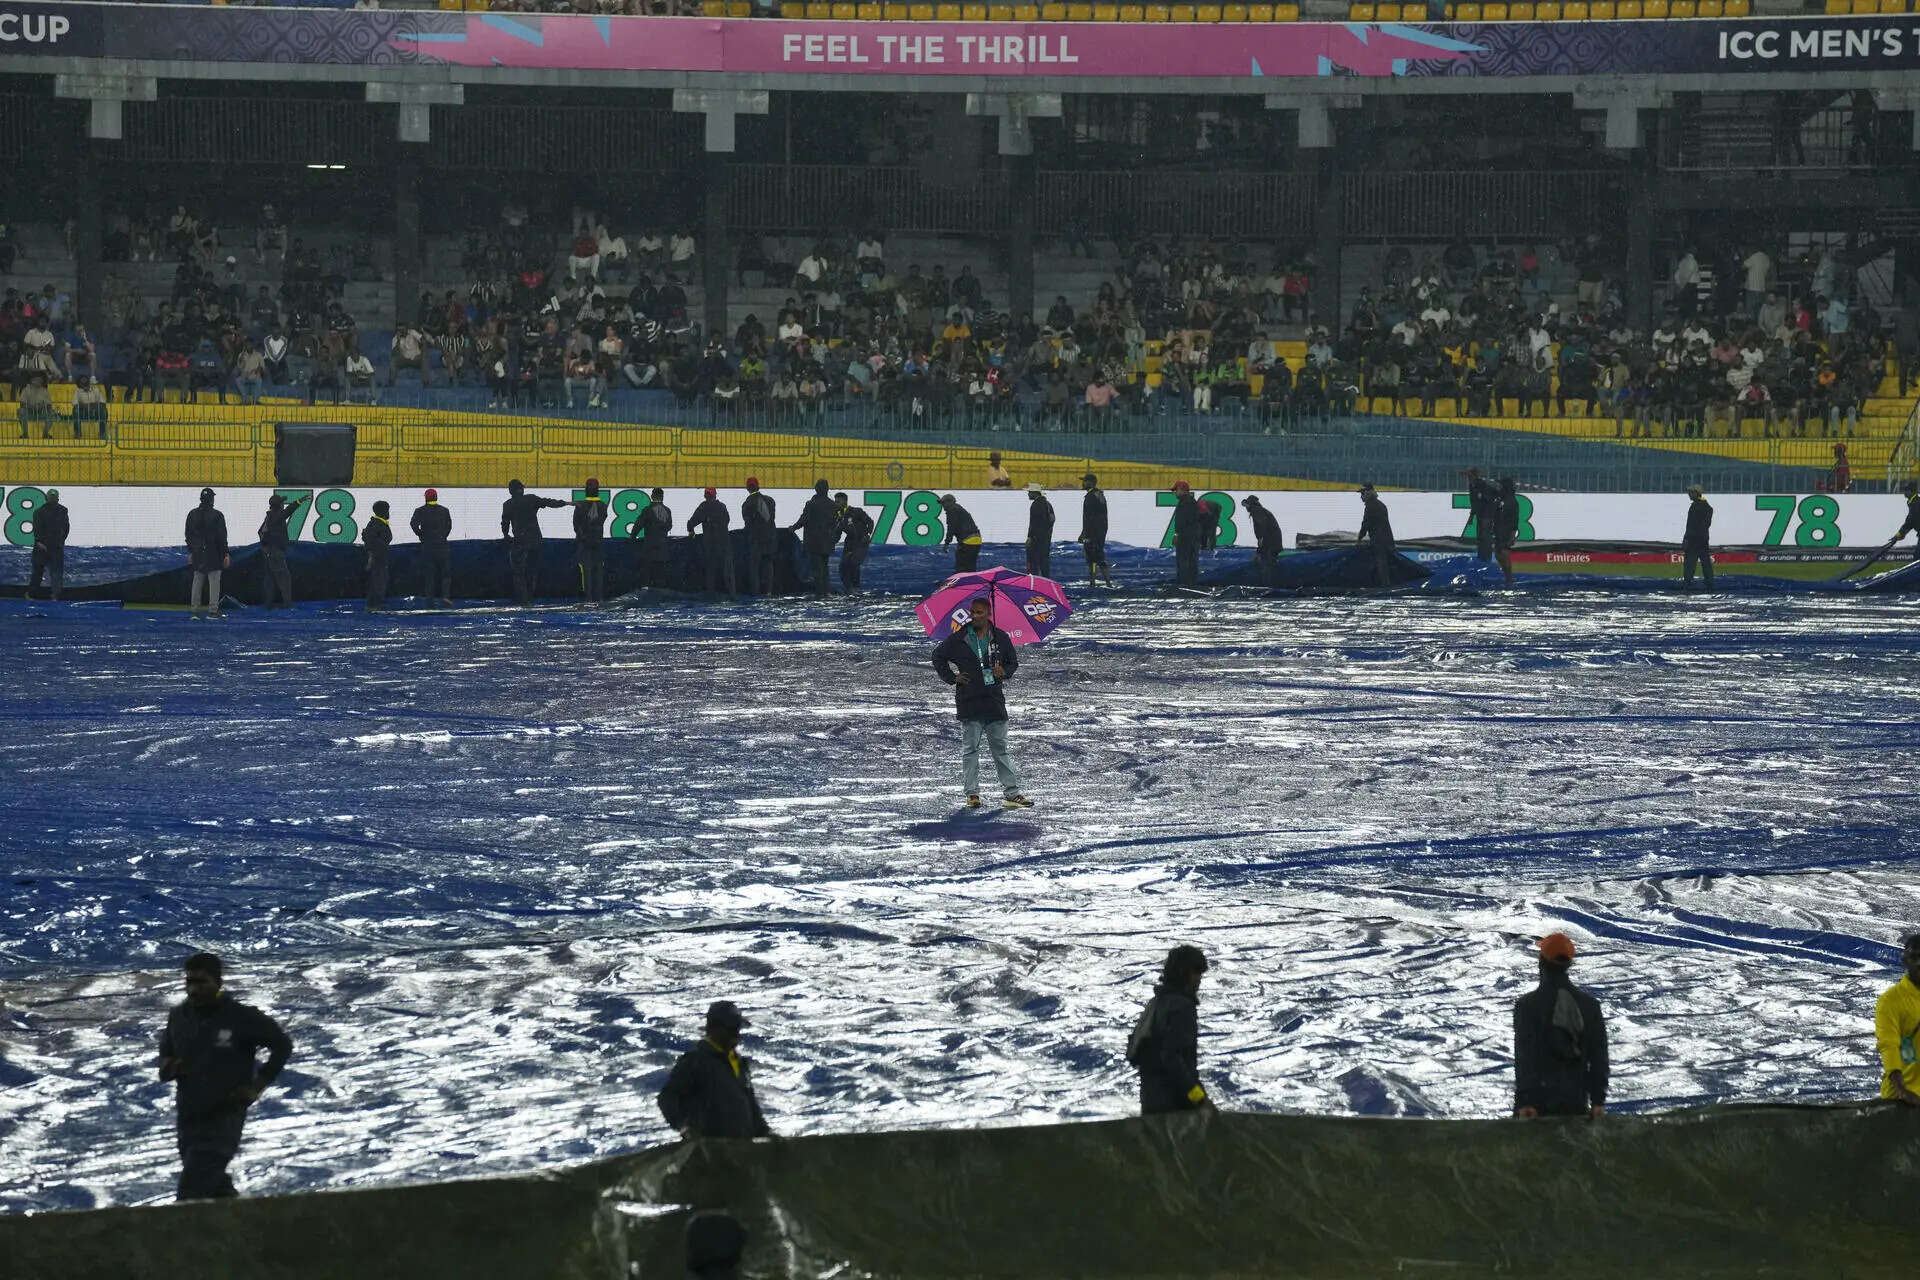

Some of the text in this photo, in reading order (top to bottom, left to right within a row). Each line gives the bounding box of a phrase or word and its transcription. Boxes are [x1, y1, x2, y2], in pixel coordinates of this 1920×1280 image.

[0, 13, 70, 43] CUP
[783, 34, 1079, 63] FEEL THE THRILL
[1718, 30, 1780, 59] ICC
[1790, 28, 1903, 58] MEN'S
[0, 486, 47, 546] 8
[273, 488, 359, 543] 78
[572, 489, 652, 538] 8
[863, 490, 944, 545] 78
[1755, 494, 1842, 547] 78
[1546, 552, 1591, 563] Emirates
